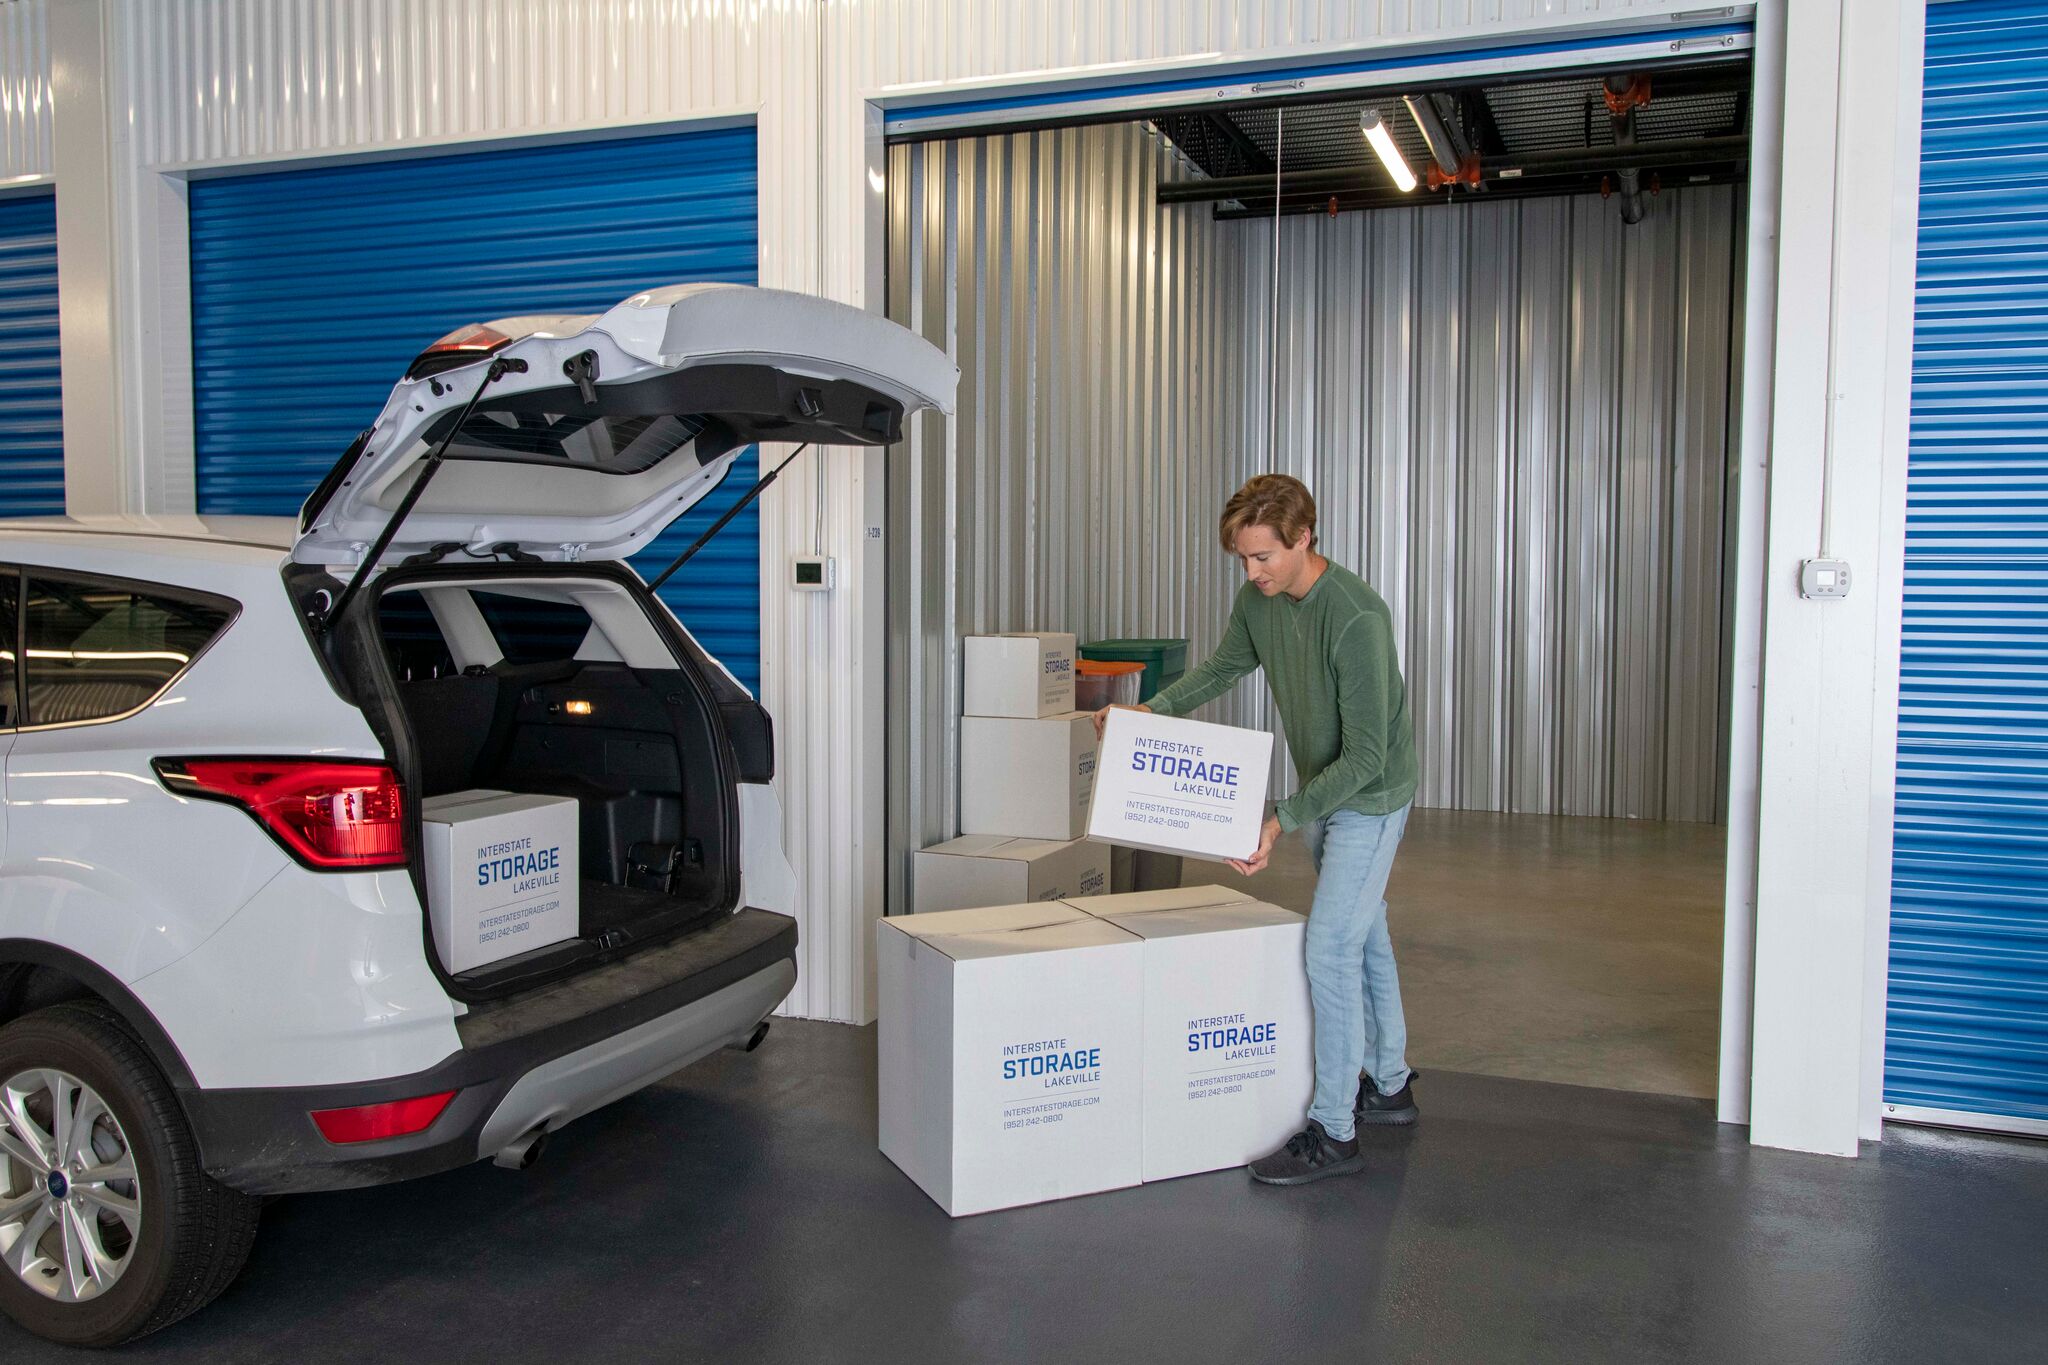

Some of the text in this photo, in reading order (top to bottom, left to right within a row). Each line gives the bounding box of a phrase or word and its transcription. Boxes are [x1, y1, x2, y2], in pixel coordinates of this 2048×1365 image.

[1045, 659, 1070, 674] STORAGE
[1135, 737, 1204, 757] INTERSTATE
[1078, 759, 1096, 776] STORA
[1132, 751, 1240, 786] STORAGE
[1174, 782, 1236, 800] LAKEVILLE
[1125, 812, 1190, 830] (952) 242-0800
[1126, 800, 1233, 824] INTERSTATESTORAGE.COM
[478, 837, 531, 859] INTERSTATE
[478, 847, 560, 886] STORAGE
[513, 872, 560, 894] LAKEVILLE
[479, 900, 560, 929] INTERSTATESTORAGE.COM
[1188, 1013, 1245, 1030] INTERSTATE
[1003, 1038, 1066, 1056] INTERSTATE
[1188, 1023, 1277, 1052] STORAGE
[1225, 1045, 1276, 1061] LAKEVILLE
[1003, 1048, 1100, 1079] STORAGE
[1044, 1071, 1100, 1088] LAKEVILLE
[1188, 1068, 1276, 1088] INTERSTATESTORAGE.COM
[1003, 1096, 1100, 1117] INTERSTATESTORAGE.COM
[1003, 1113, 1063, 1130] (952) 242-0800
